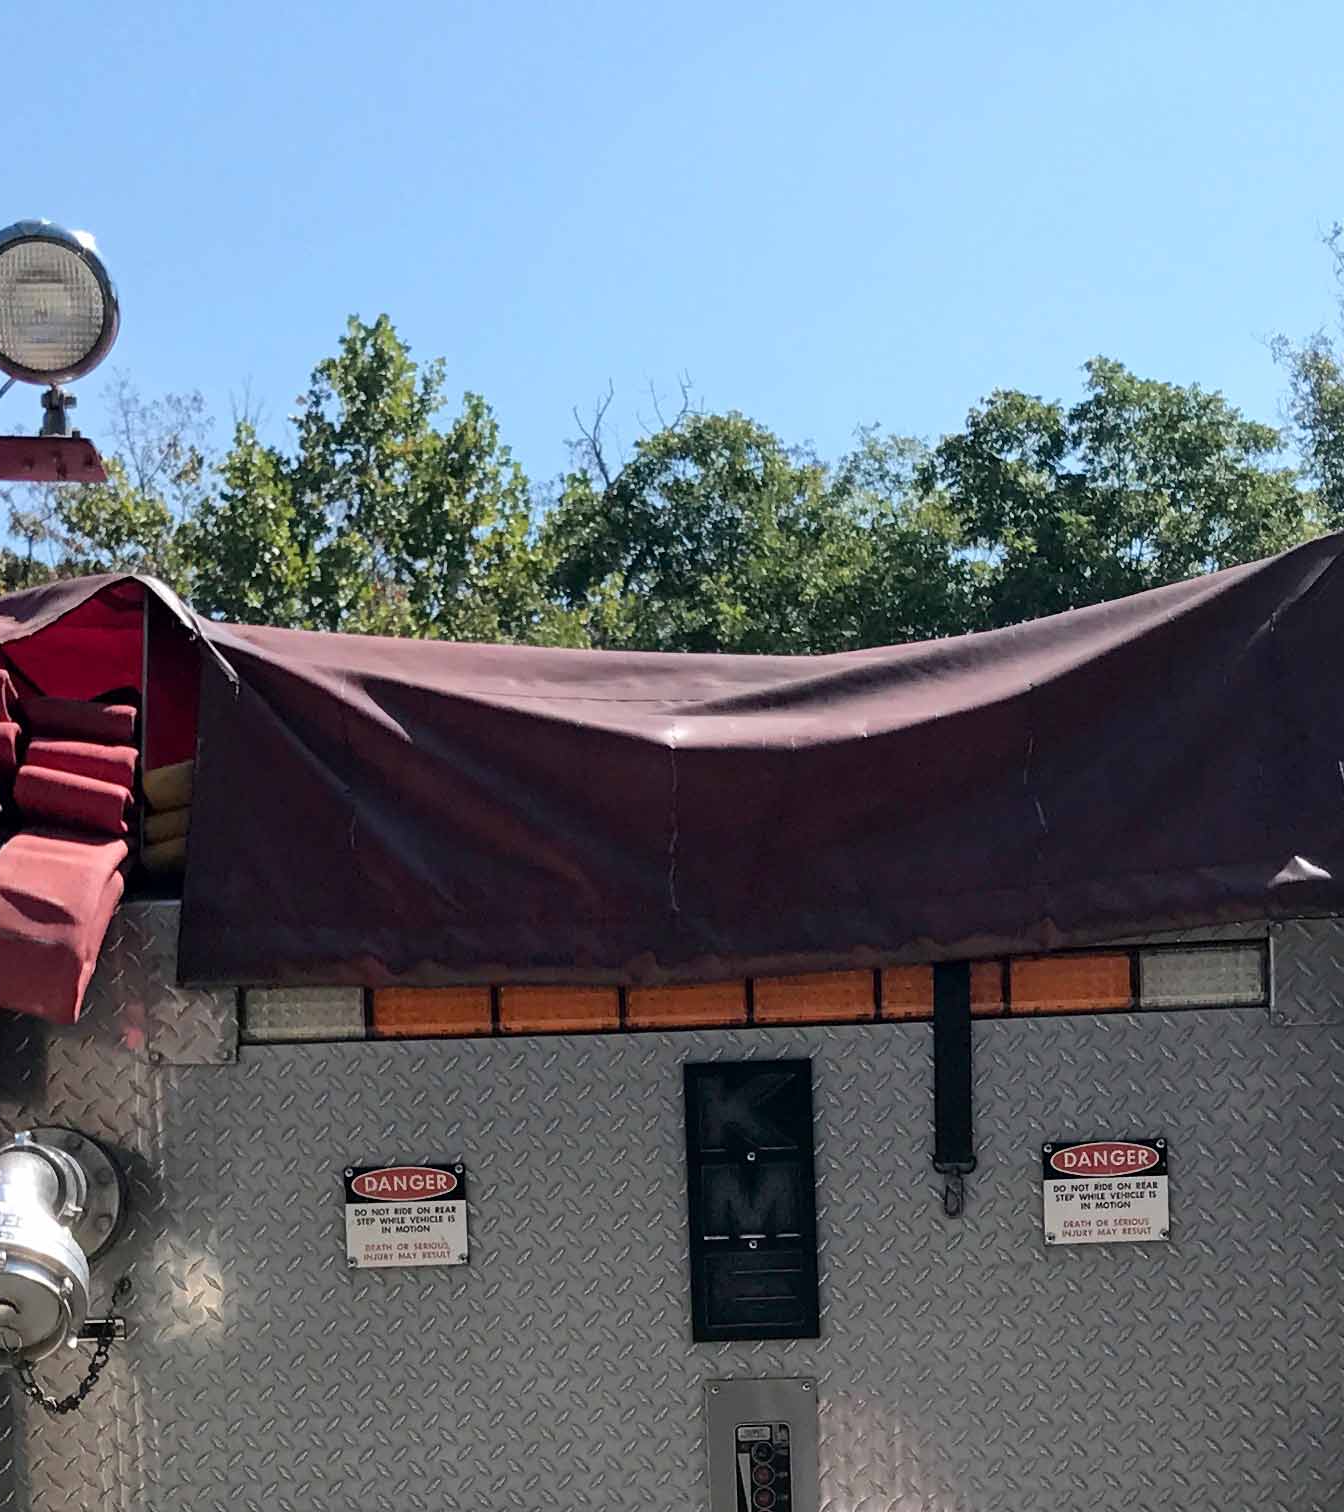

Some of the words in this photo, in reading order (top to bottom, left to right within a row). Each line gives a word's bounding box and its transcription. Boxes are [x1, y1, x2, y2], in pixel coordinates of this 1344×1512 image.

[1063, 1149, 1150, 1168] DANGER
[364, 1174, 448, 1193] DANGER
[1053, 1185, 1066, 1193] DO
[1071, 1184, 1089, 1192] NOT
[1094, 1183, 1113, 1191] RIDE
[1117, 1182, 1131, 1190] ON
[1136, 1181, 1158, 1189] REAR
[1055, 1193, 1074, 1202] STEP
[1110, 1191, 1145, 1200] VEHICLE
[1149, 1190, 1156, 1198] IS
[354, 1208, 367, 1216] DO
[371, 1207, 390, 1216] NOT
[394, 1207, 412, 1215] RIDE
[417, 1206, 431, 1214] ON
[435, 1205, 456, 1214] REAR
[1081, 1202, 1091, 1210] IN
[1096, 1201, 1131, 1209] MOTION
[356, 1217, 376, 1226] STEP
[379, 1216, 406, 1225] WHILE
[409, 1215, 443, 1224] VEHICLE
[448, 1215, 456, 1223] IS
[1064, 1220, 1091, 1228] DEATH
[1096, 1219, 1108, 1227] OR
[1114, 1218, 1150, 1226] SERIOUS
[381, 1225, 391, 1234] IN
[396, 1225, 430, 1233] MOTION
[1062, 1229, 1092, 1238] INJURY
[1097, 1228, 1116, 1236] MAY
[1122, 1226, 1152, 1235] RESULT
[365, 1243, 392, 1252] DEATH
[414, 1242, 449, 1250] SERIOUS
[363, 1253, 393, 1261] INJURY
[398, 1252, 416, 1260] MAY
[422, 1250, 451, 1259] RESULT
